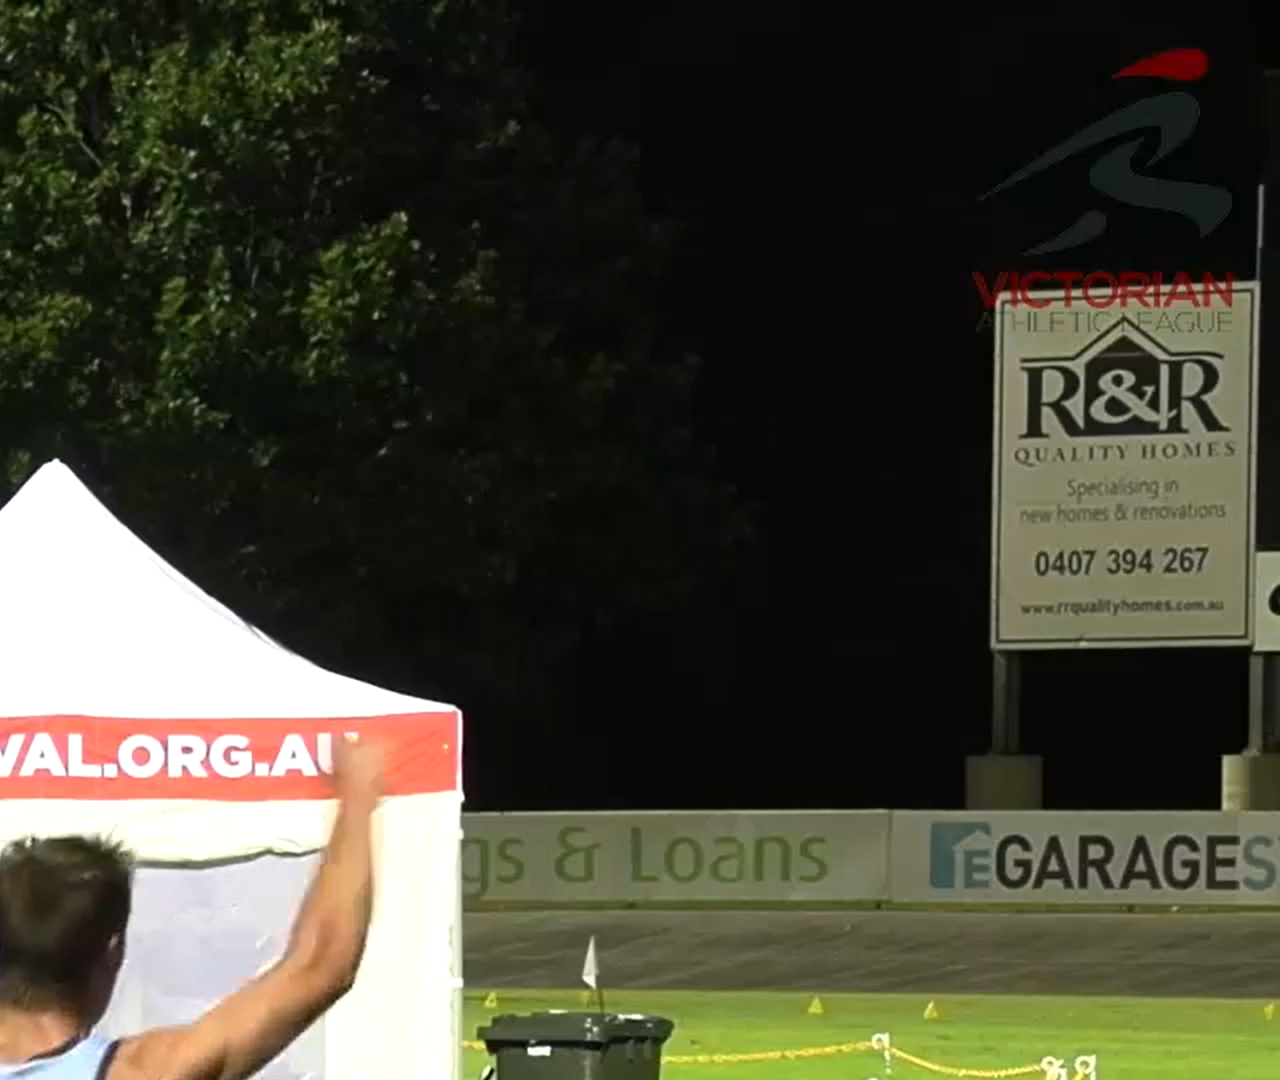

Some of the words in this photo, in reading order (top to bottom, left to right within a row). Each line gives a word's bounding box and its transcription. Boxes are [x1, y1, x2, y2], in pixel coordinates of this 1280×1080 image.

[1018, 358, 1231, 440] R&R
[1014, 443, 1130, 467] QUALITY
[1142, 440, 1237, 460] HOMES
[1067, 478, 1159, 503] Specialising
[1165, 478, 1179, 494] in
[1020, 508, 1051, 523] new
[1057, 504, 1108, 523] homes
[1114, 504, 1128, 521] &
[1133, 503, 1226, 521] renovations
[1034, 550, 1096, 576] 0407
[1107, 549, 1153, 574] 394
[1163, 547, 1209, 574] 267
[1020, 599, 1225, 617] www.rrqualityhomes.com.au
[555, 826, 601, 882] &
[630, 826, 828, 883] Loans
